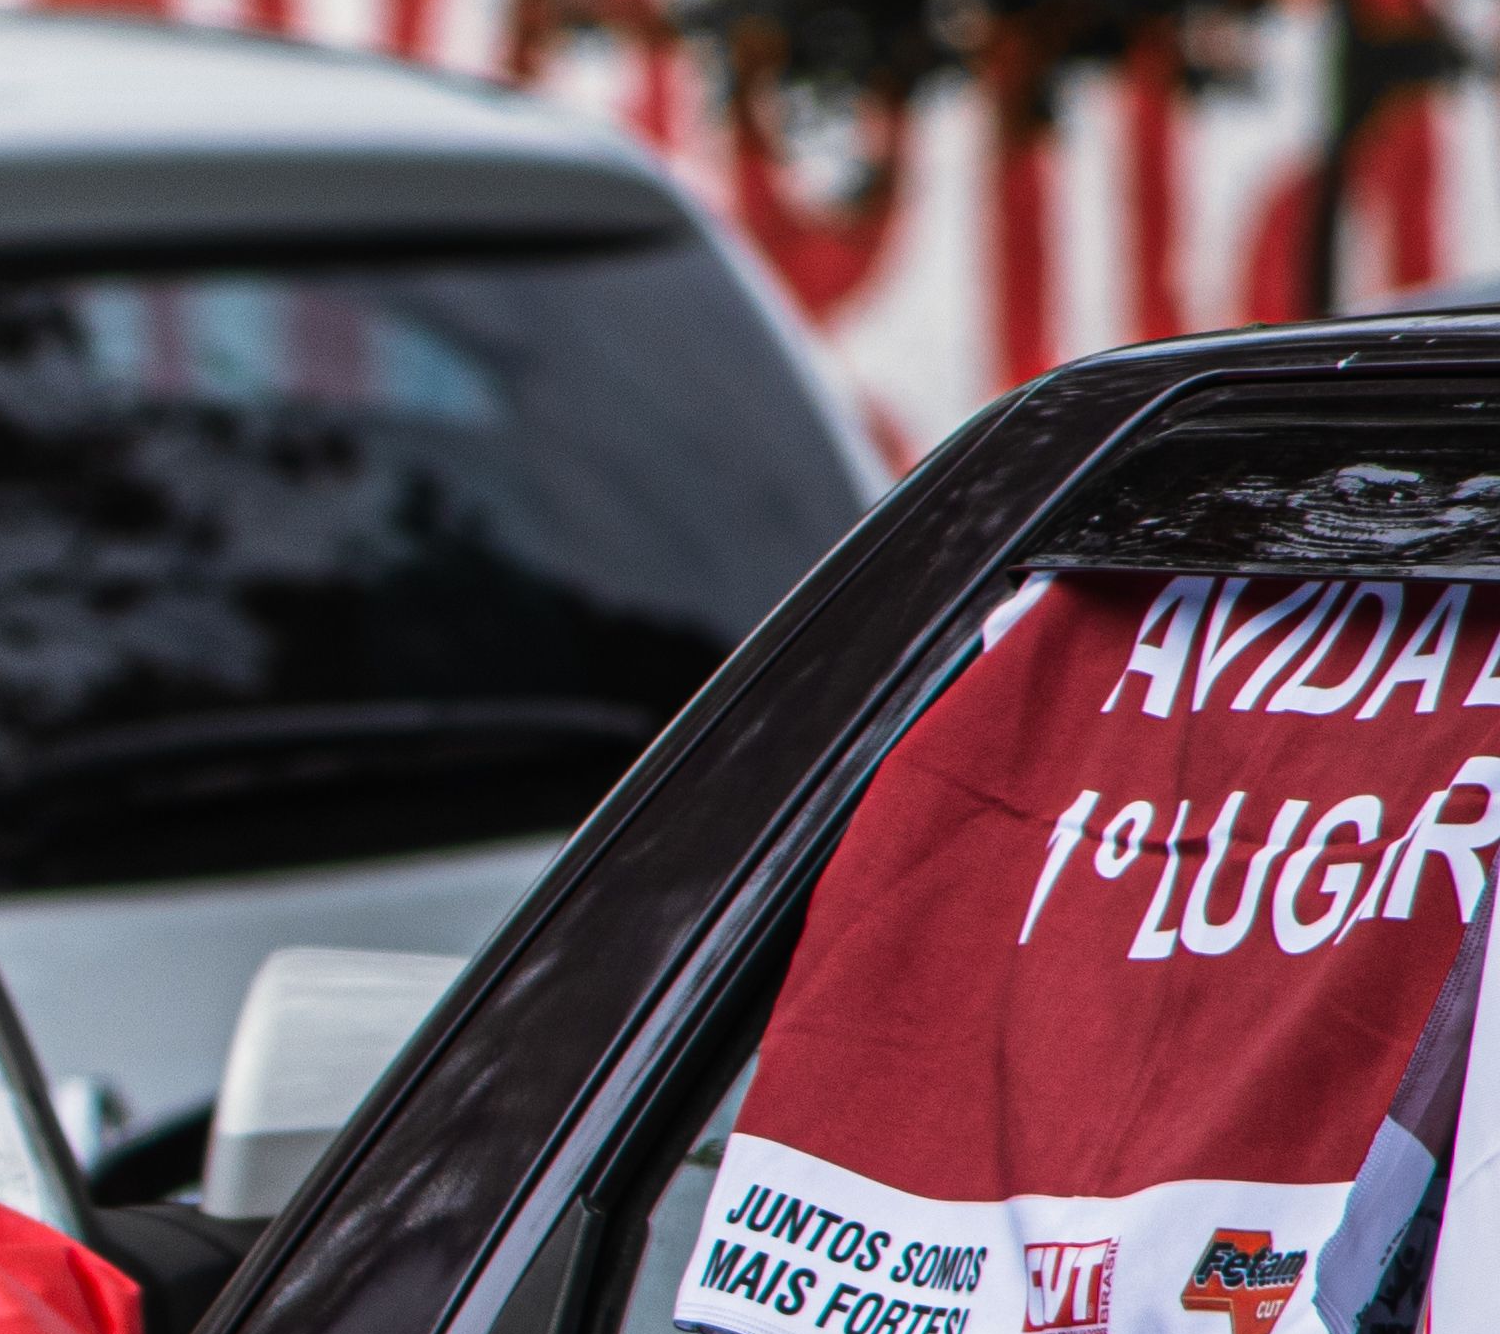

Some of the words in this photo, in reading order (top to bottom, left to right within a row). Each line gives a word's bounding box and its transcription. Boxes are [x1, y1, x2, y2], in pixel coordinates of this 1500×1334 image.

[699, 1238, 818, 1316] MAIS
[726, 1184, 892, 1272] JUNTOS
[889, 1241, 988, 1294] SOMOS
